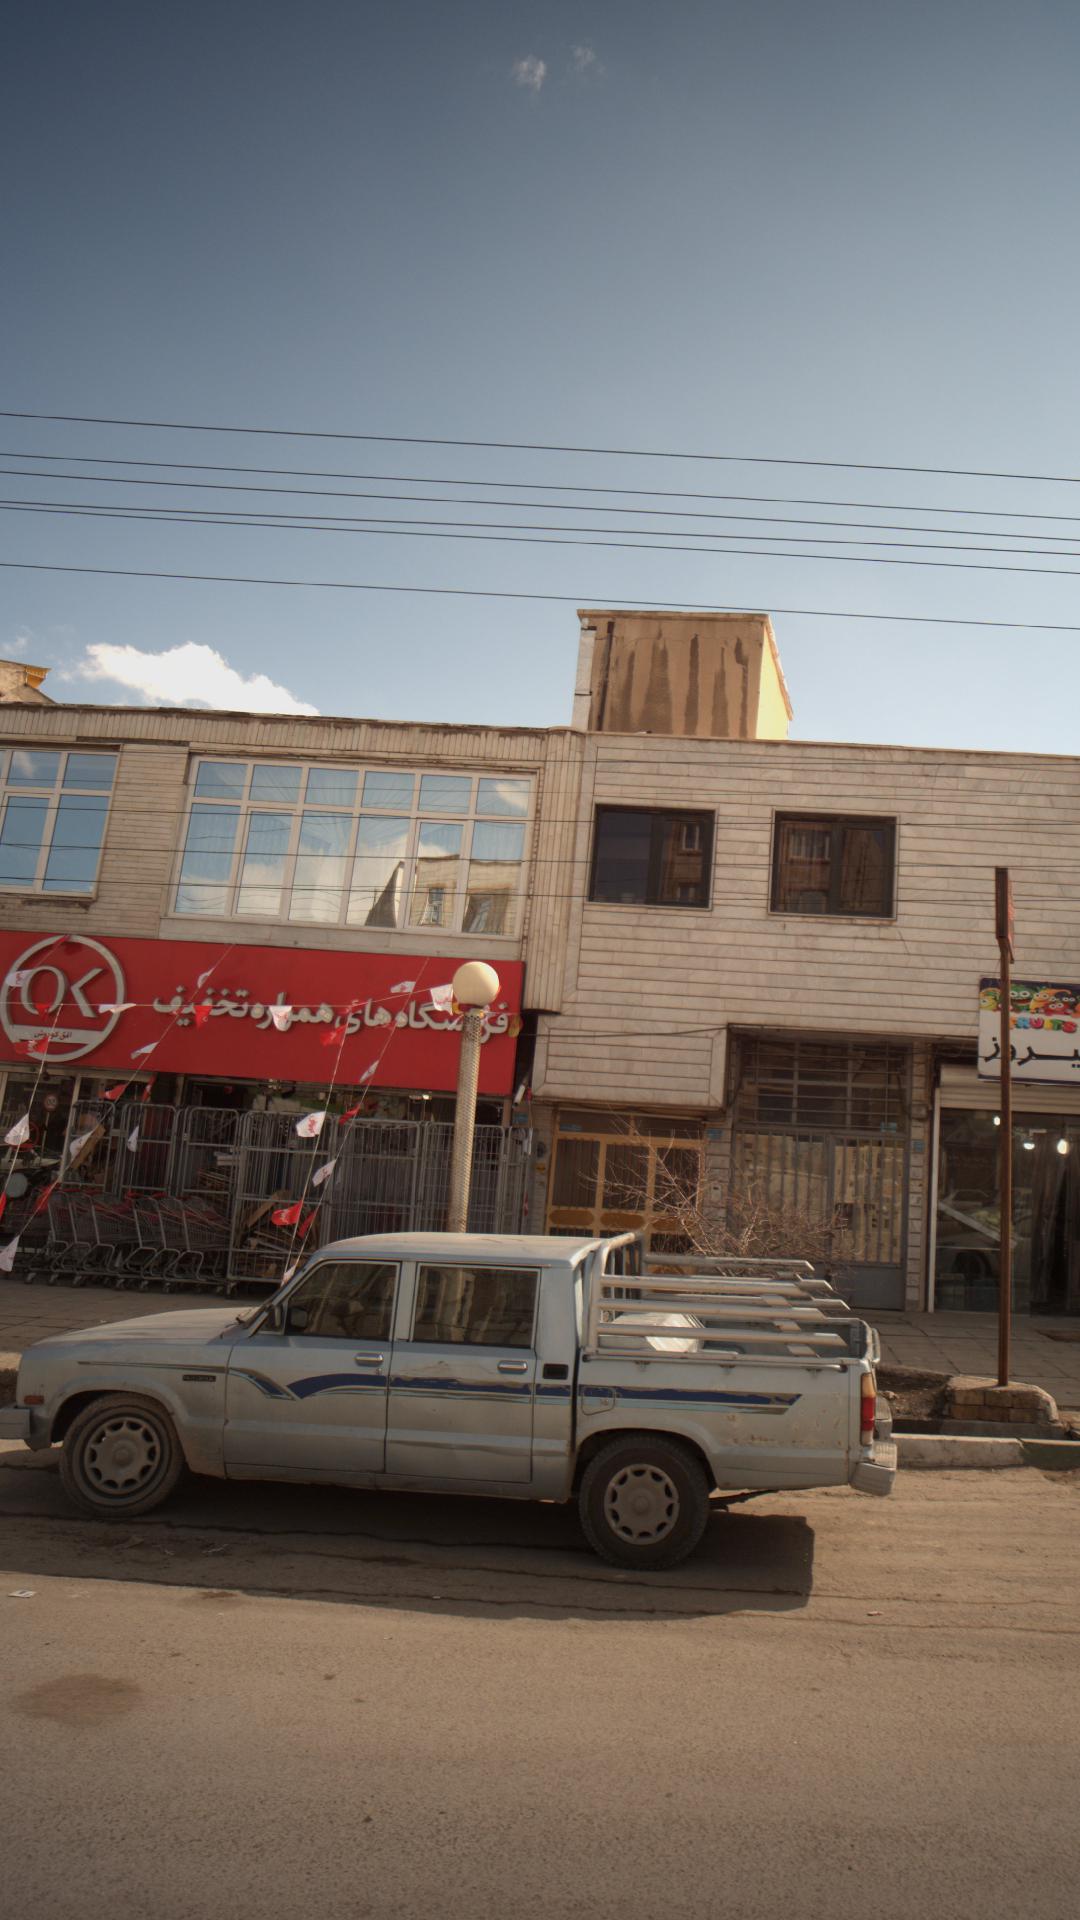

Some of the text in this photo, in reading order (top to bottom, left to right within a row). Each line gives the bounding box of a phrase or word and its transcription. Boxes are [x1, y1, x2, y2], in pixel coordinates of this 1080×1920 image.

[21, 966, 104, 1018] OK
[152, 985, 249, 1027] تخفیف
[334, 999, 392, 1034] های
[395, 1000, 508, 1043] فرشگاه
